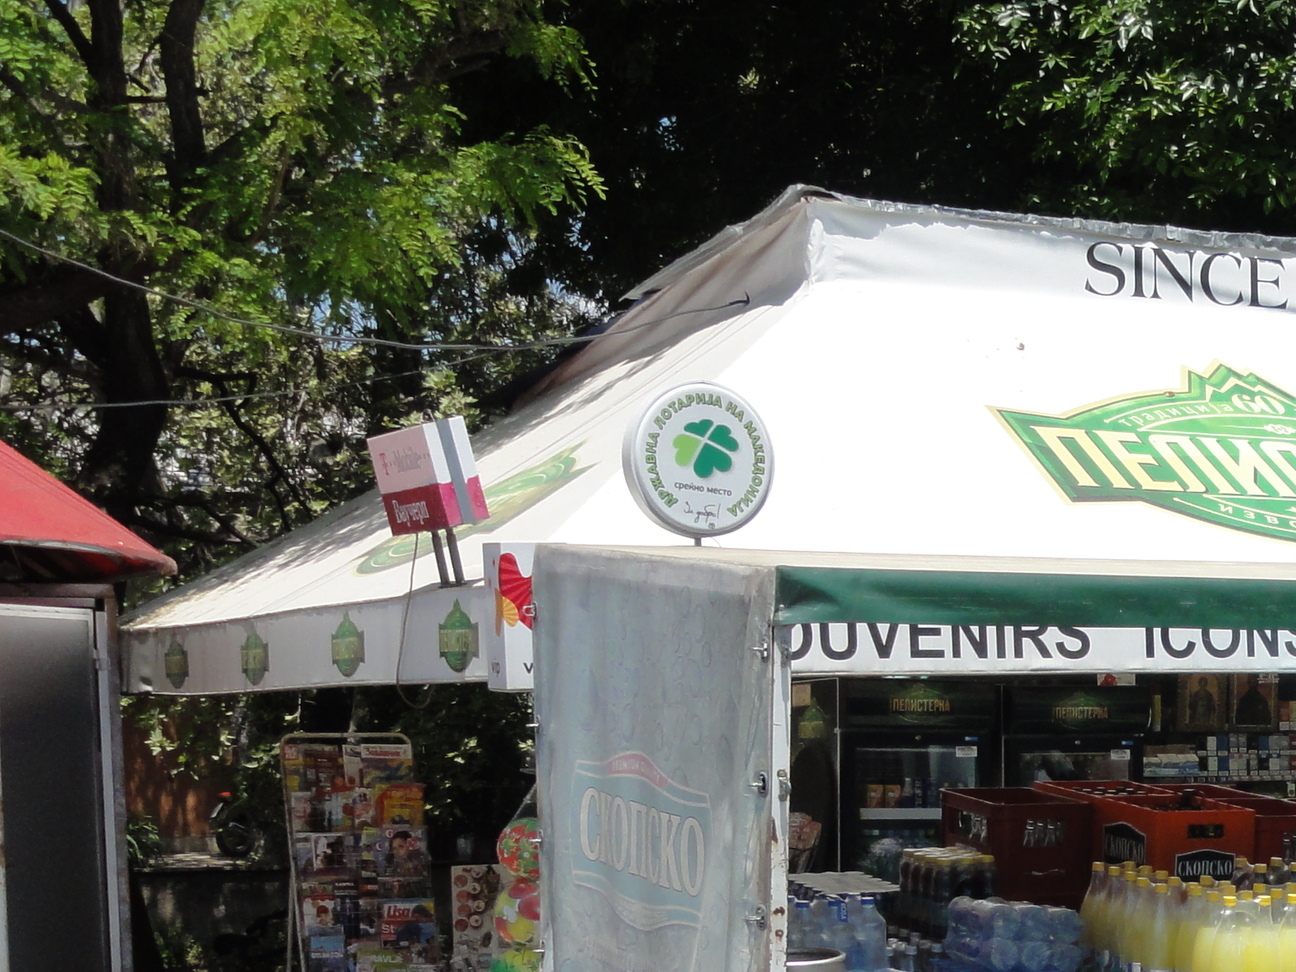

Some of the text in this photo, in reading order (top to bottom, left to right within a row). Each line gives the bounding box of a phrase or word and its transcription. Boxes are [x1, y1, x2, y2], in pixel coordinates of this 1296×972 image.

[1084, 241, 1289, 310] SINCE
[1118, 402, 1235, 427] традиција
[1231, 393, 1286, 416] 60
[645, 393, 765, 517] ДРЖАВНА ЛОТАРИЈА НА МАКЕДОНИЈА
[674, 481, 733, 497] среќно место
[791, 623, 1091, 660] OUVENIRS
[580, 786, 705, 897] СКОПСКО
[1178, 860, 1233, 877] СКОПСКО
